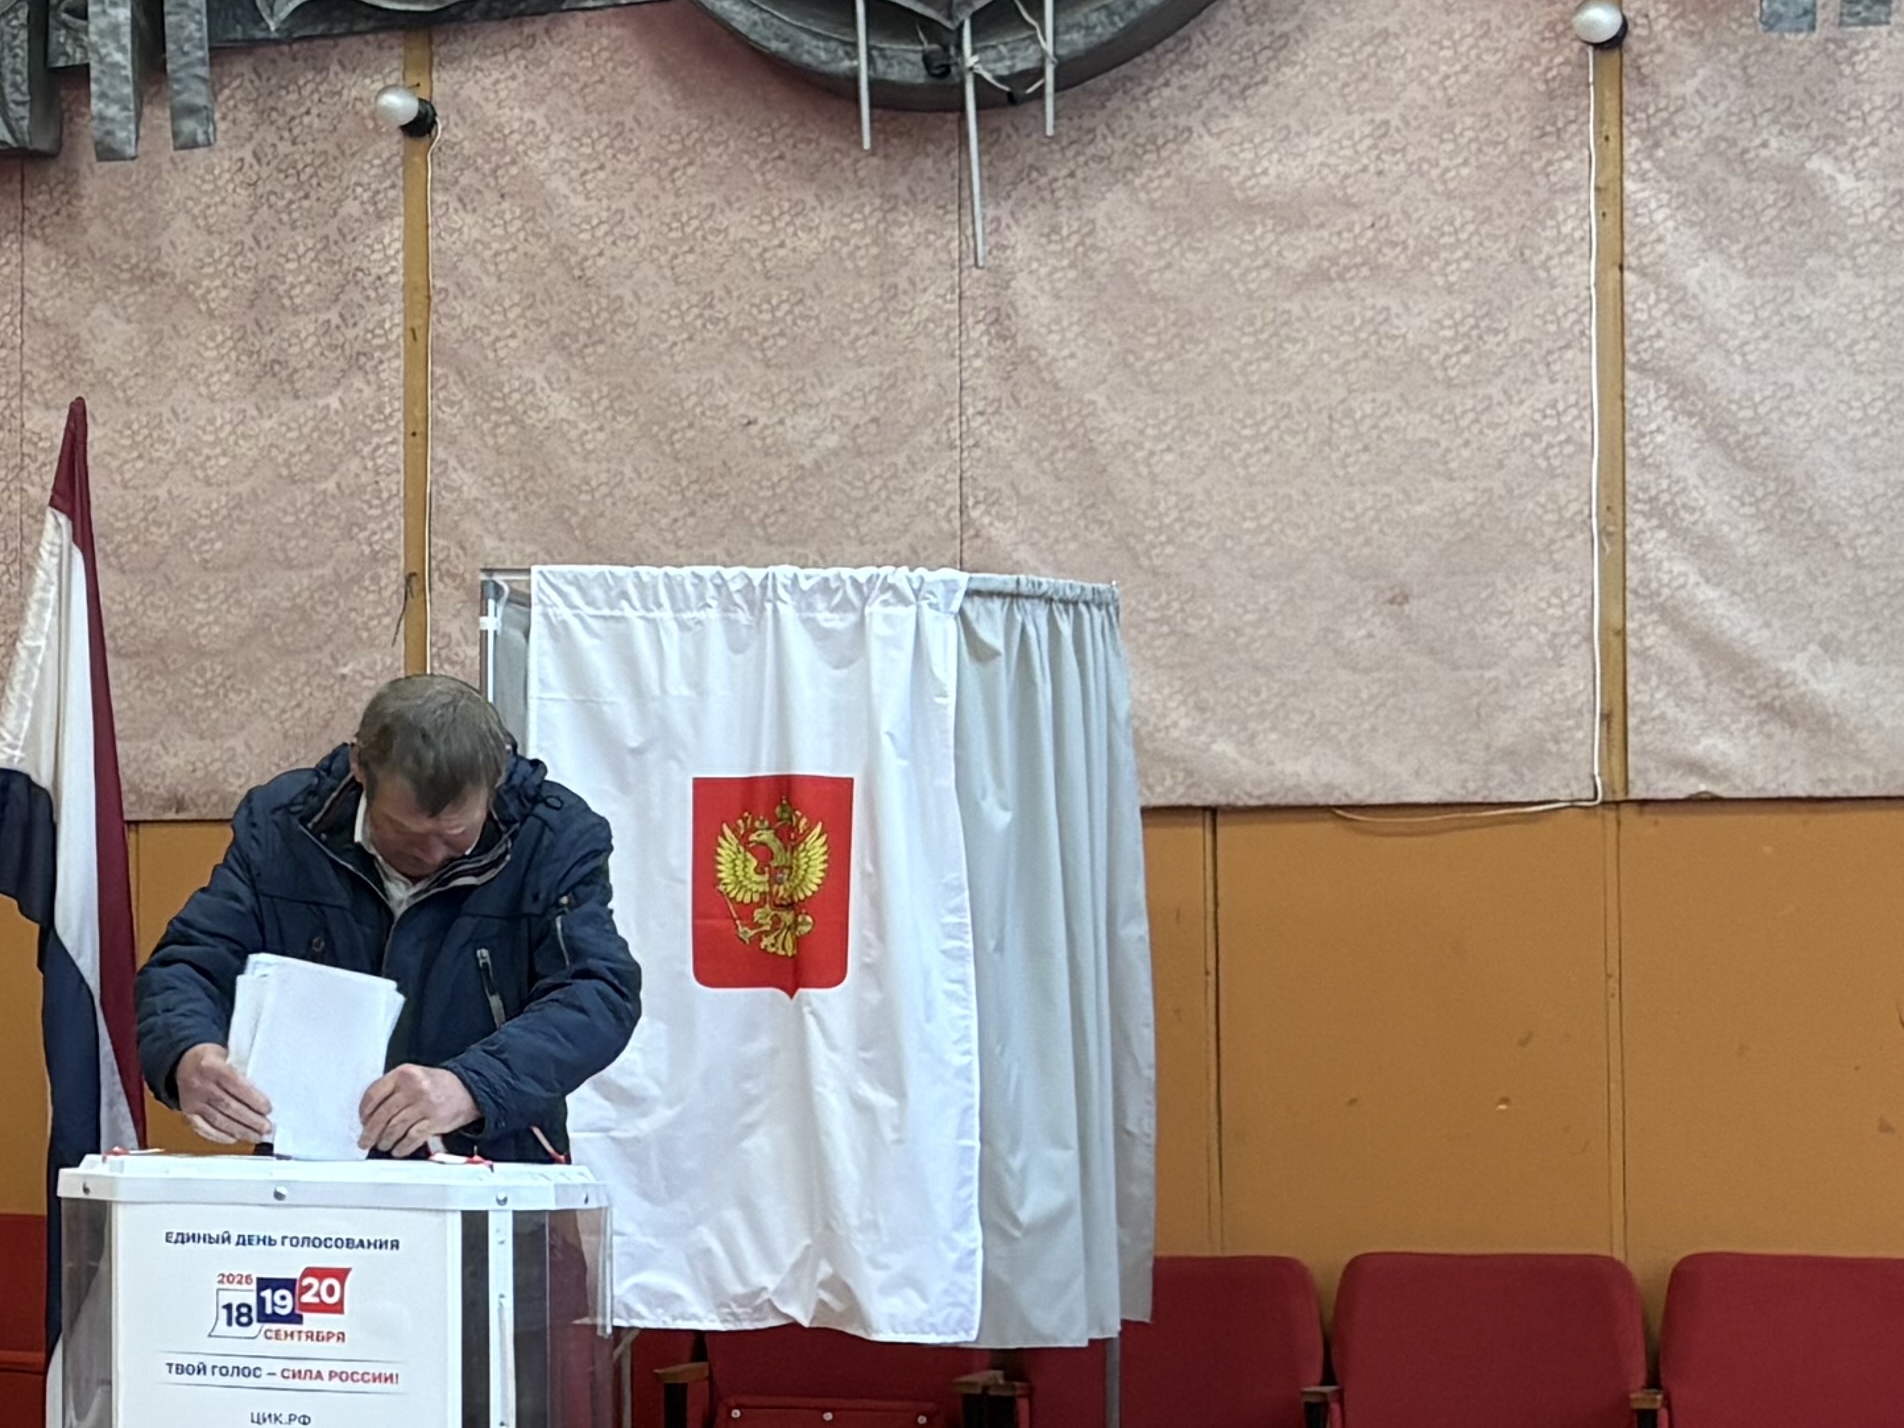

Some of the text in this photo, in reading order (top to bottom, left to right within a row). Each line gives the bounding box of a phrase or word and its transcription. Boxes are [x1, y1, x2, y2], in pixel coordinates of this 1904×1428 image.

[164, 1229, 400, 1252] ЕДИНЫЙ ДЕНЬ ГОЛОСОВАНИЯ
[217, 1272, 254, 1286] 2026
[299, 1276, 342, 1306] 20
[260, 1287, 294, 1316] 19
[221, 1302, 254, 1328] 18
[264, 1327, 346, 1344] СЕНТЯБРЯ
[166, 1360, 207, 1378] ТВОЙ
[211, 1364, 263, 1379] ГОЛОС
[280, 1367, 324, 1383] СИЛА
[327, 1369, 400, 1386] РОССИИ!
[250, 1410, 312, 1428] ЦИК.РФ
